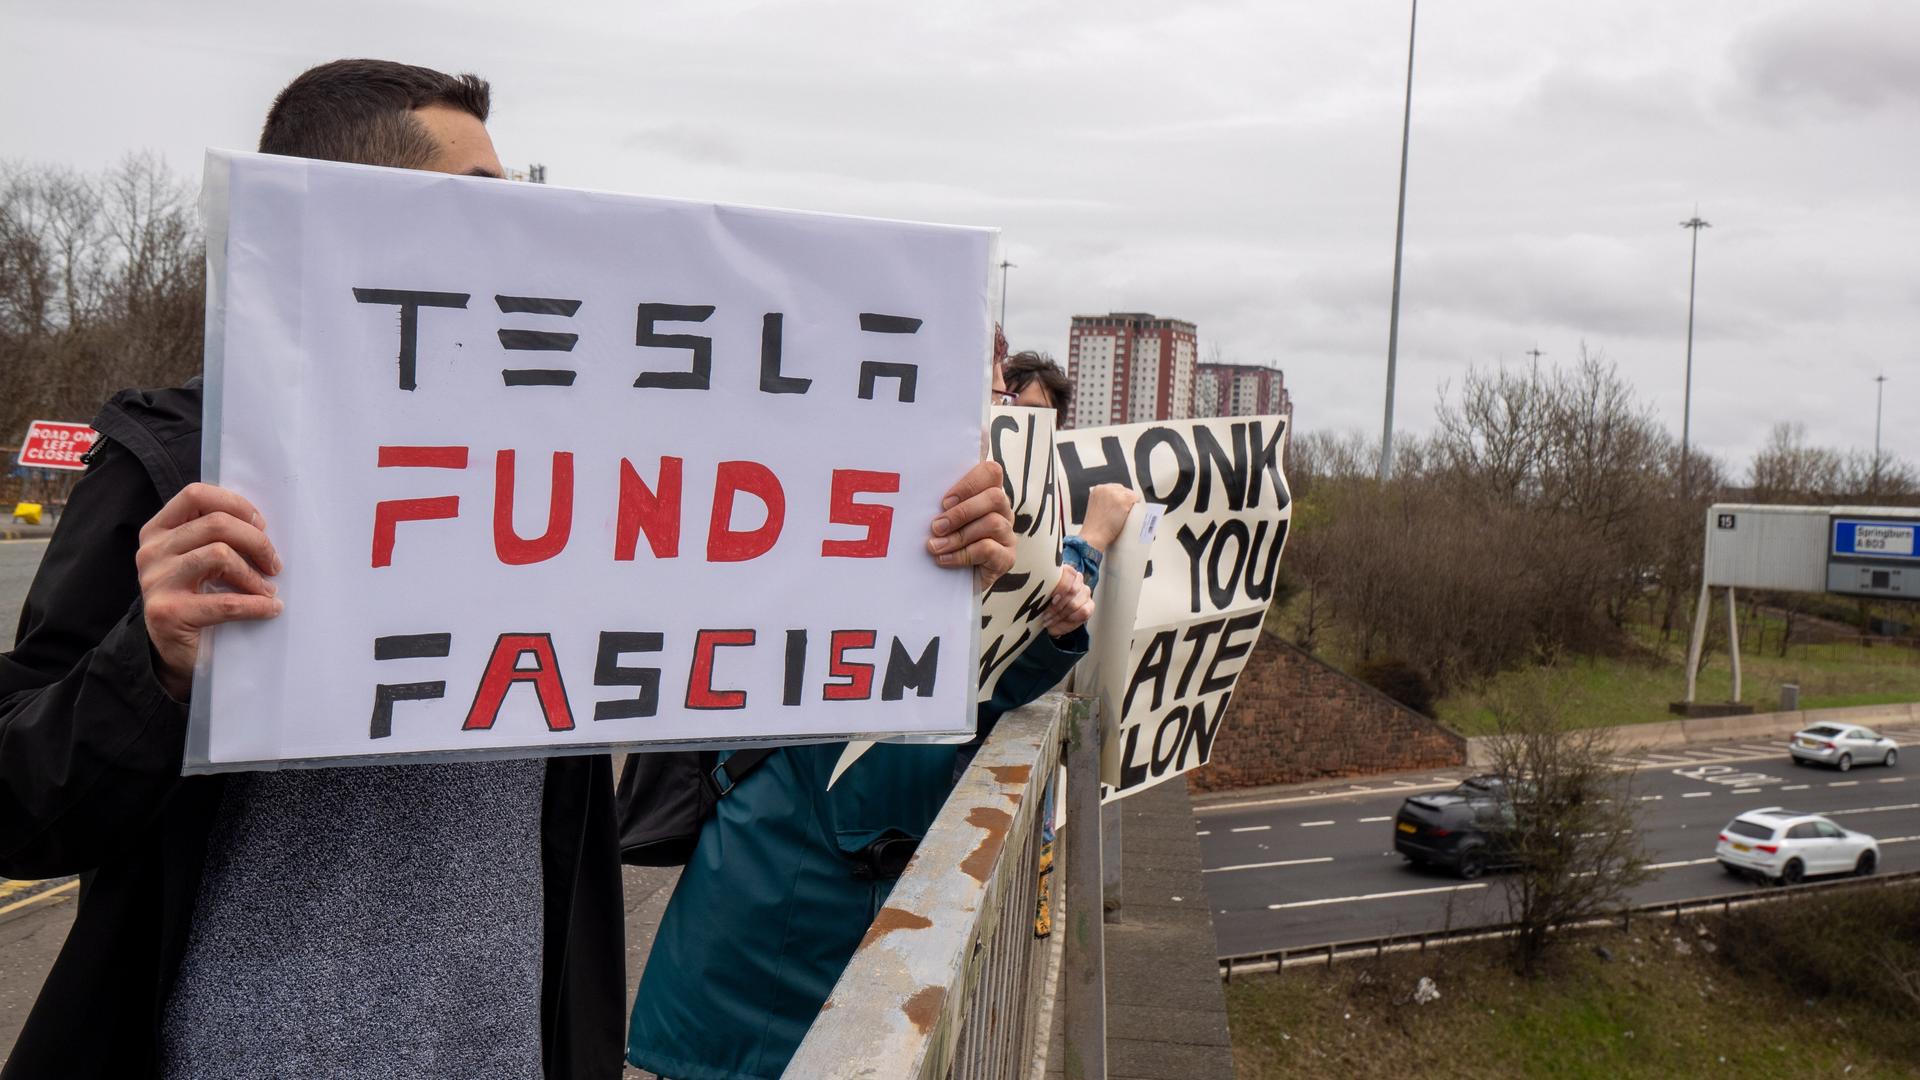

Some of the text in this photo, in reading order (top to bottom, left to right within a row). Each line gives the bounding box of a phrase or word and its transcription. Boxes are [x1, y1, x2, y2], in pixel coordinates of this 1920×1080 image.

[352, 287, 923, 403] TESLA
[31, 428, 97, 442] ROAD ON
[43, 440, 76, 450] LEFT
[1057, 420, 1291, 525] HONK
[371, 446, 901, 568] FUNDS
[1720, 516, 1733, 527] 15
[1857, 527, 1912, 539] Springburn
[1176, 519, 1288, 613] YOU
[369, 628, 940, 739] FASCISM
[1121, 610, 1265, 724] ATE
[1113, 691, 1232, 793] LON
